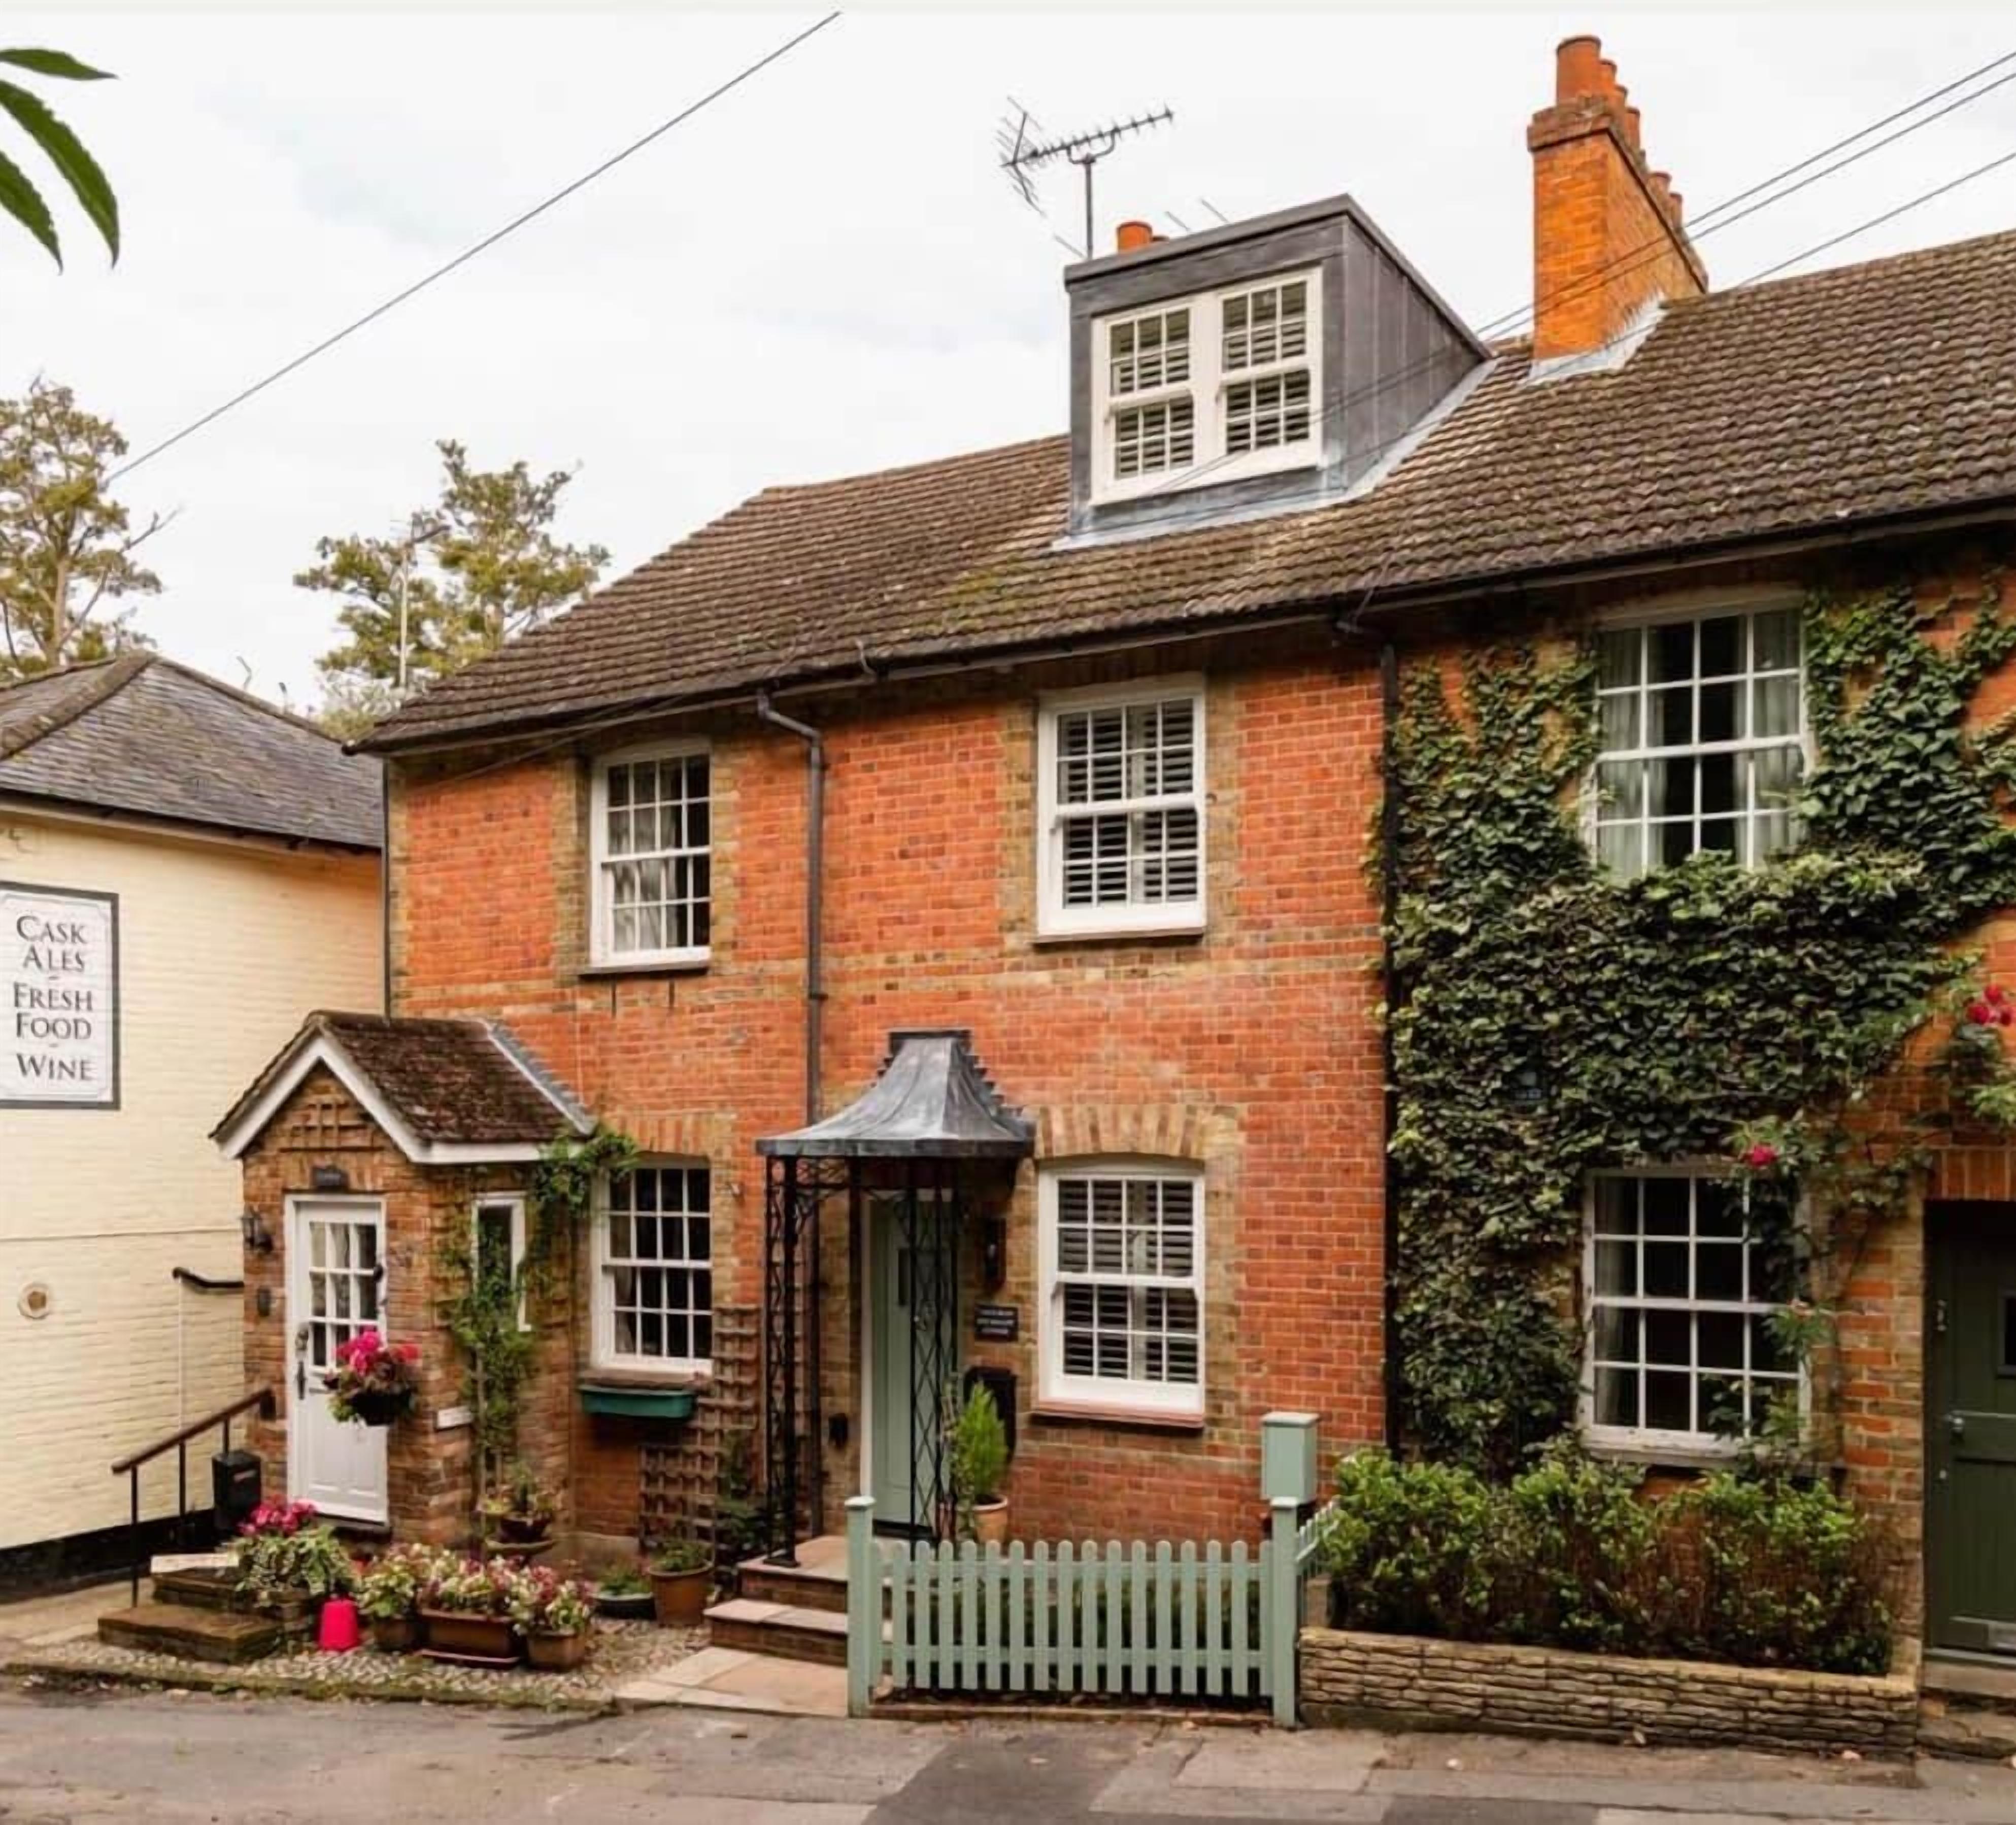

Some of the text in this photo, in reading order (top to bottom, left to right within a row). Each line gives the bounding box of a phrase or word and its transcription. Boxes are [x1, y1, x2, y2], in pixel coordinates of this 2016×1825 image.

[17, 916, 87, 943] CASK
[23, 945, 85, 971] ALES
[14, 982, 92, 1011] FRESH
[17, 1013, 91, 1039] FOOD
[17, 1054, 93, 1081] WINE
